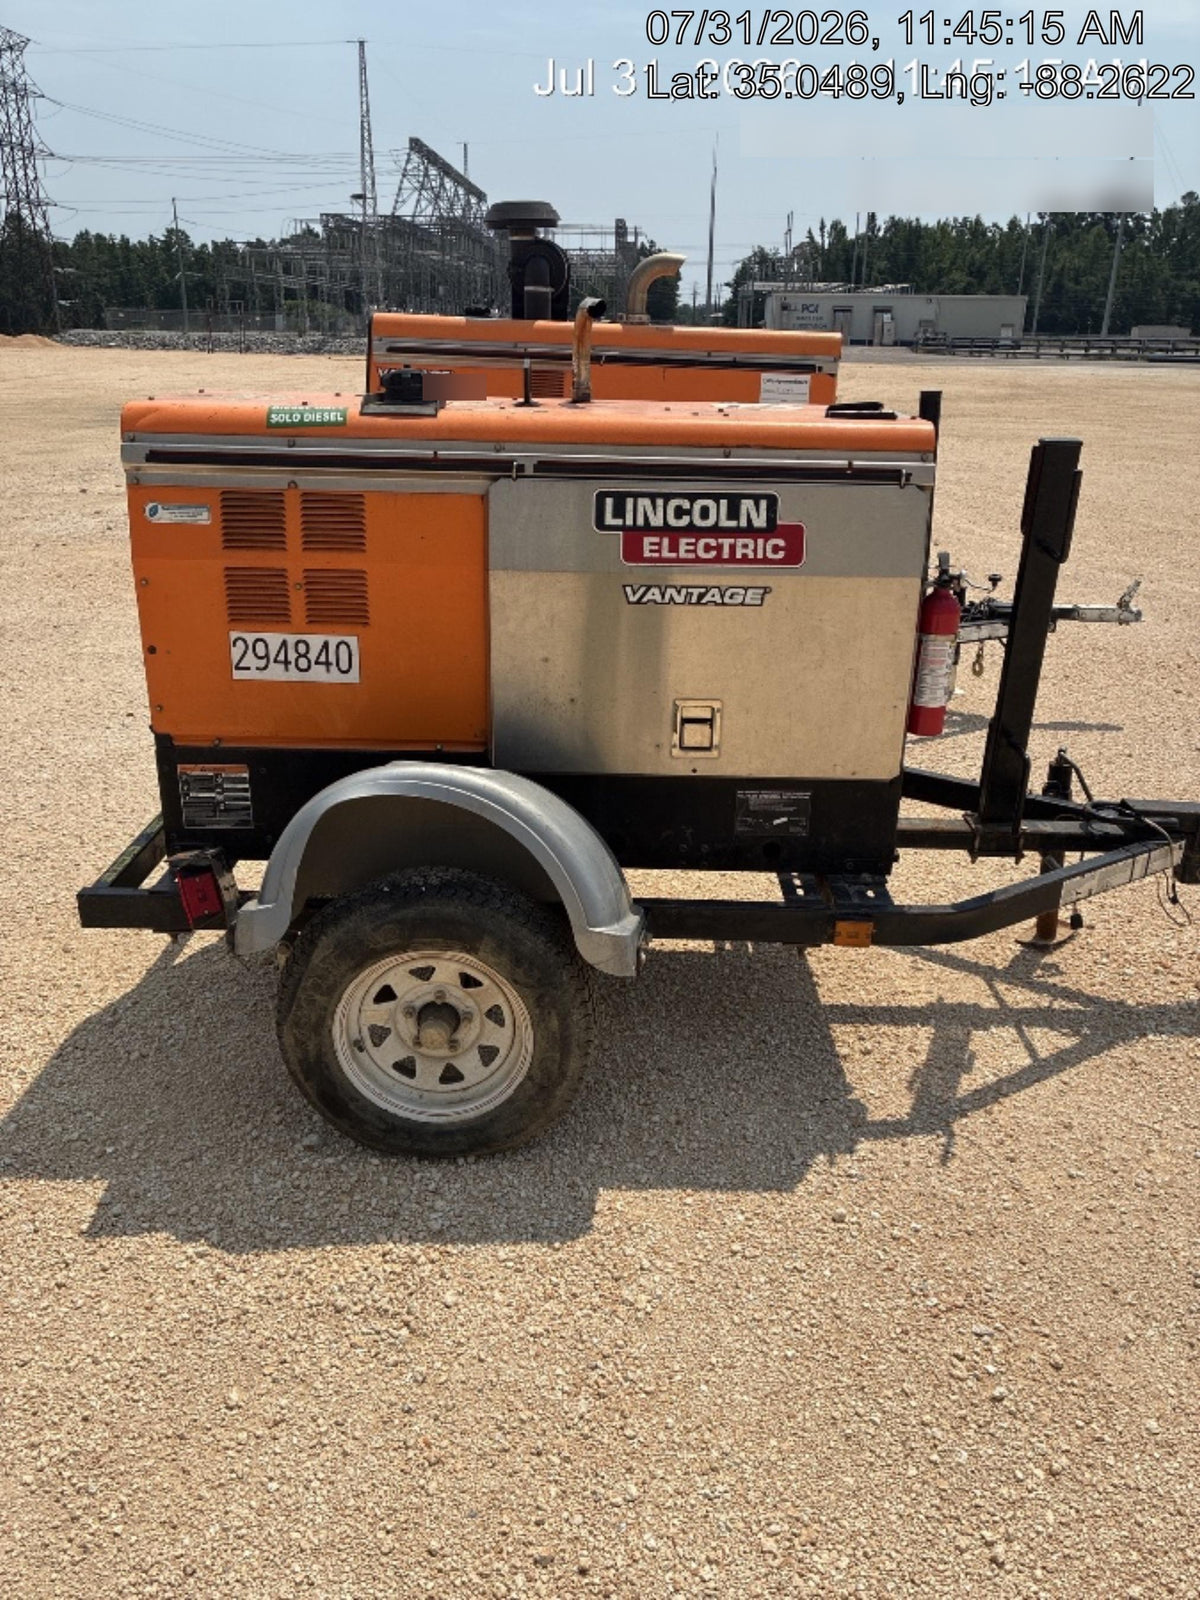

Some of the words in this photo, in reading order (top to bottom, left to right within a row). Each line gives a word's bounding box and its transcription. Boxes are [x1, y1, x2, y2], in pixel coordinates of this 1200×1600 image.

[270, 413, 300, 423] SOLO
[303, 411, 344, 422] DIESEL
[604, 497, 767, 528] LINCOLN
[642, 536, 786, 559] ELECTRIC
[232, 636, 353, 674] 294840
